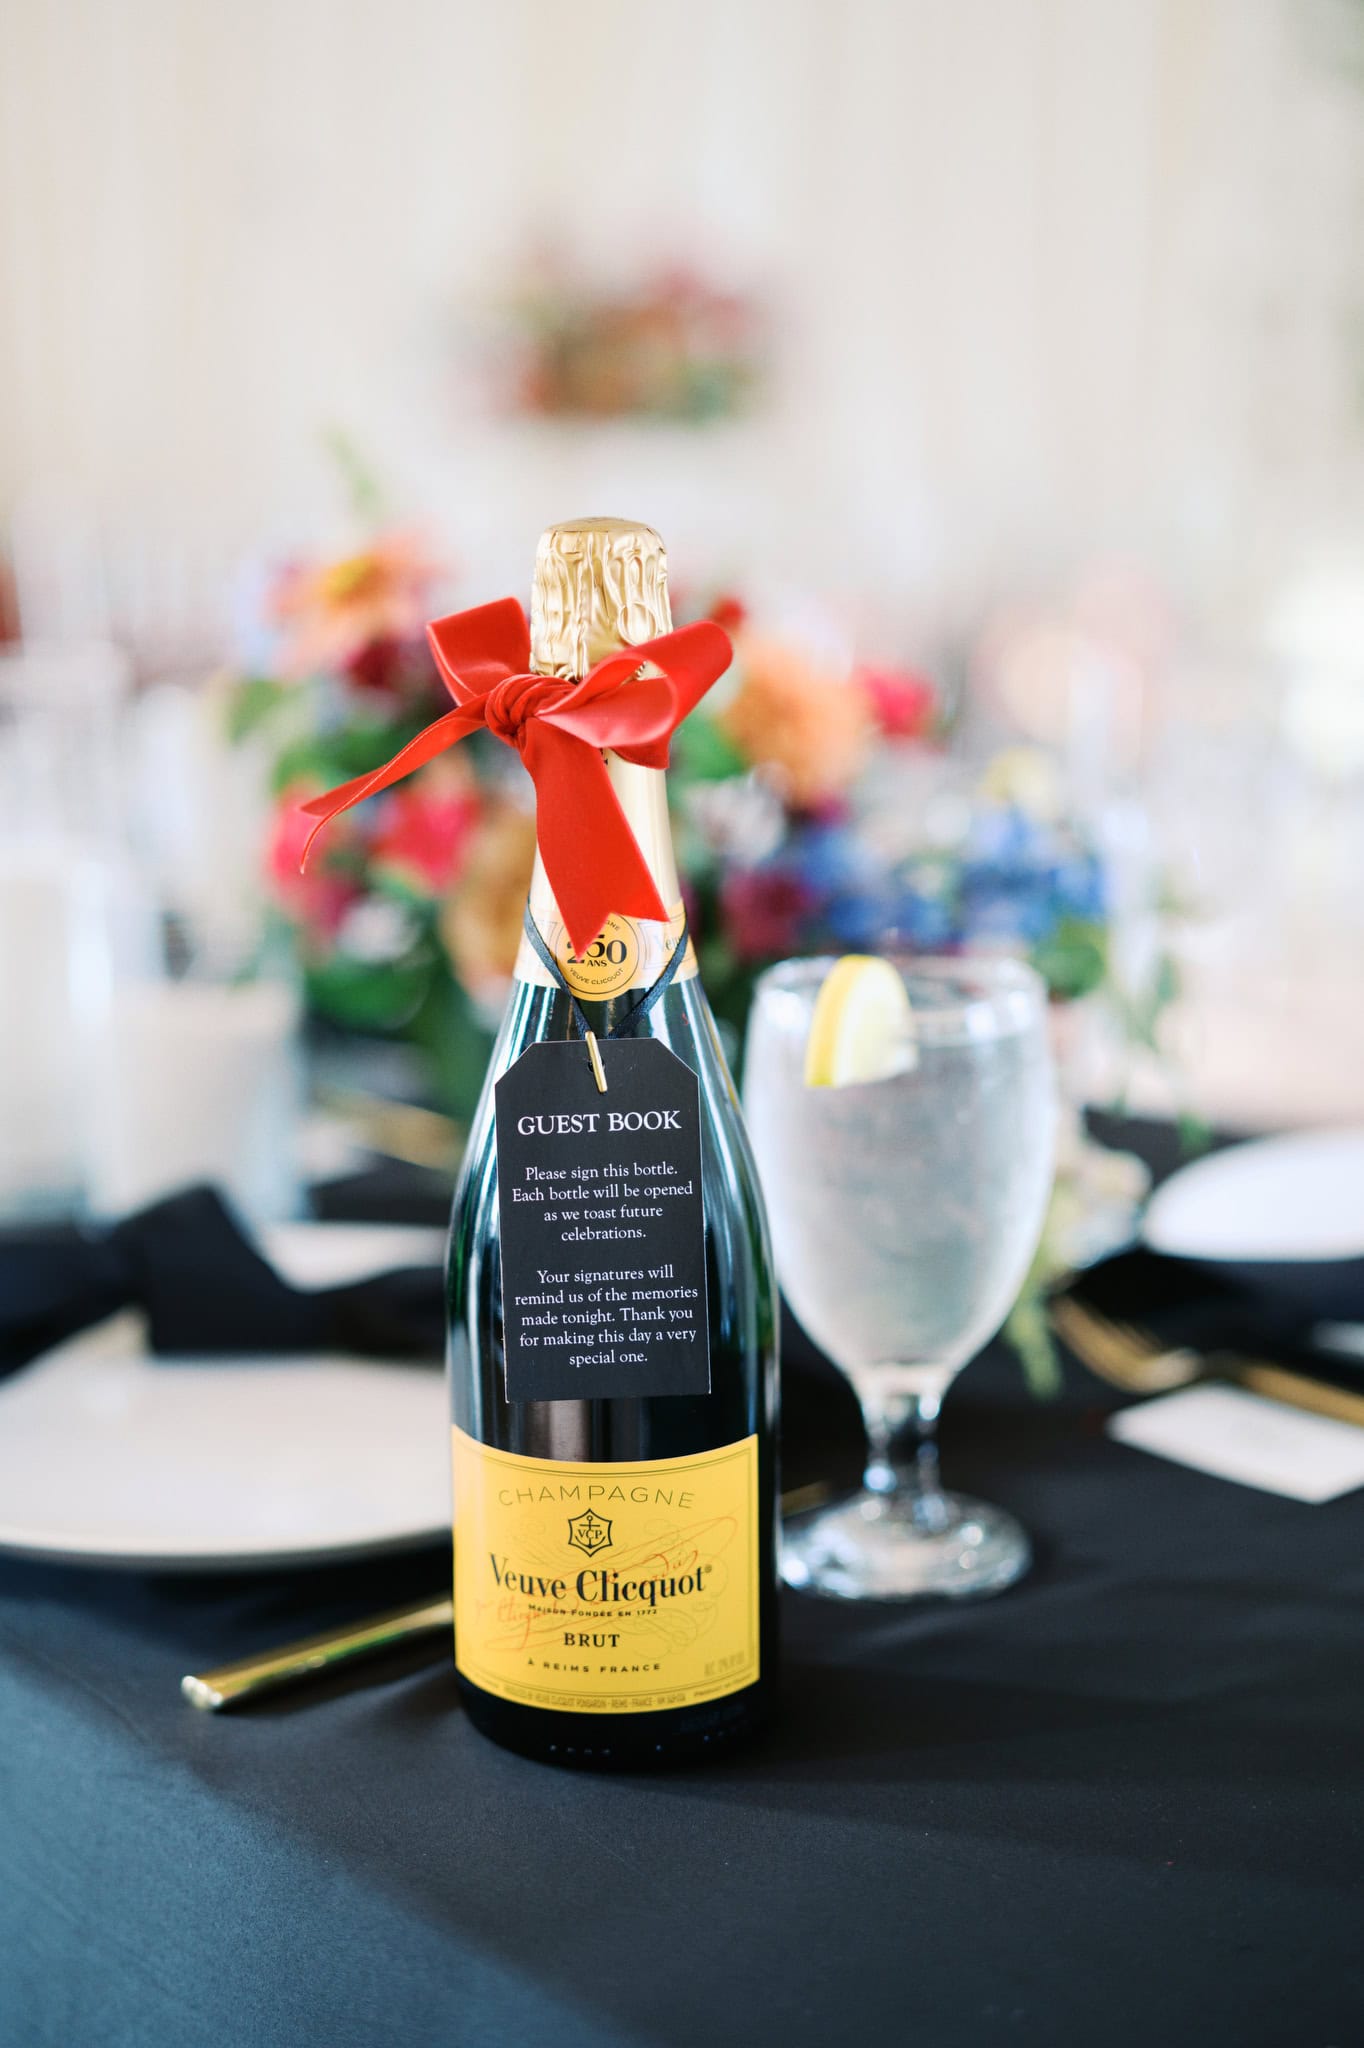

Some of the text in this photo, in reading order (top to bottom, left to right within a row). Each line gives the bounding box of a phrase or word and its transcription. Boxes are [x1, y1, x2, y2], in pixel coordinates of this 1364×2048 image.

[586, 959, 608, 968] ANS
[570, 967, 624, 985] VEUVE CLICQUOT
[518, 1110, 682, 1135] GUEST BOOK
[525, 1161, 678, 1182] Please sign this bottle.
[511, 1181, 693, 1202] Each bottle will be opened
[543, 1204, 664, 1222] as we toast future
[561, 1227, 647, 1242] celebrations.
[536, 1264, 674, 1284] Your signatures will
[514, 1286, 699, 1306] remind us of the memories
[521, 1306, 693, 1326] made tonight. Thank you
[519, 1328, 697, 1347] for making this day a very
[569, 1350, 648, 1368] special one.
[498, 1485, 696, 1509] CHAMPAGNE
[578, 1529, 603, 1539] VCP
[488, 1551, 567, 1600] Veuve
[563, 1632, 621, 1648] BRUT
[543, 1661, 590, 1672] REIMS
[600, 1663, 661, 1673] FRANCE
